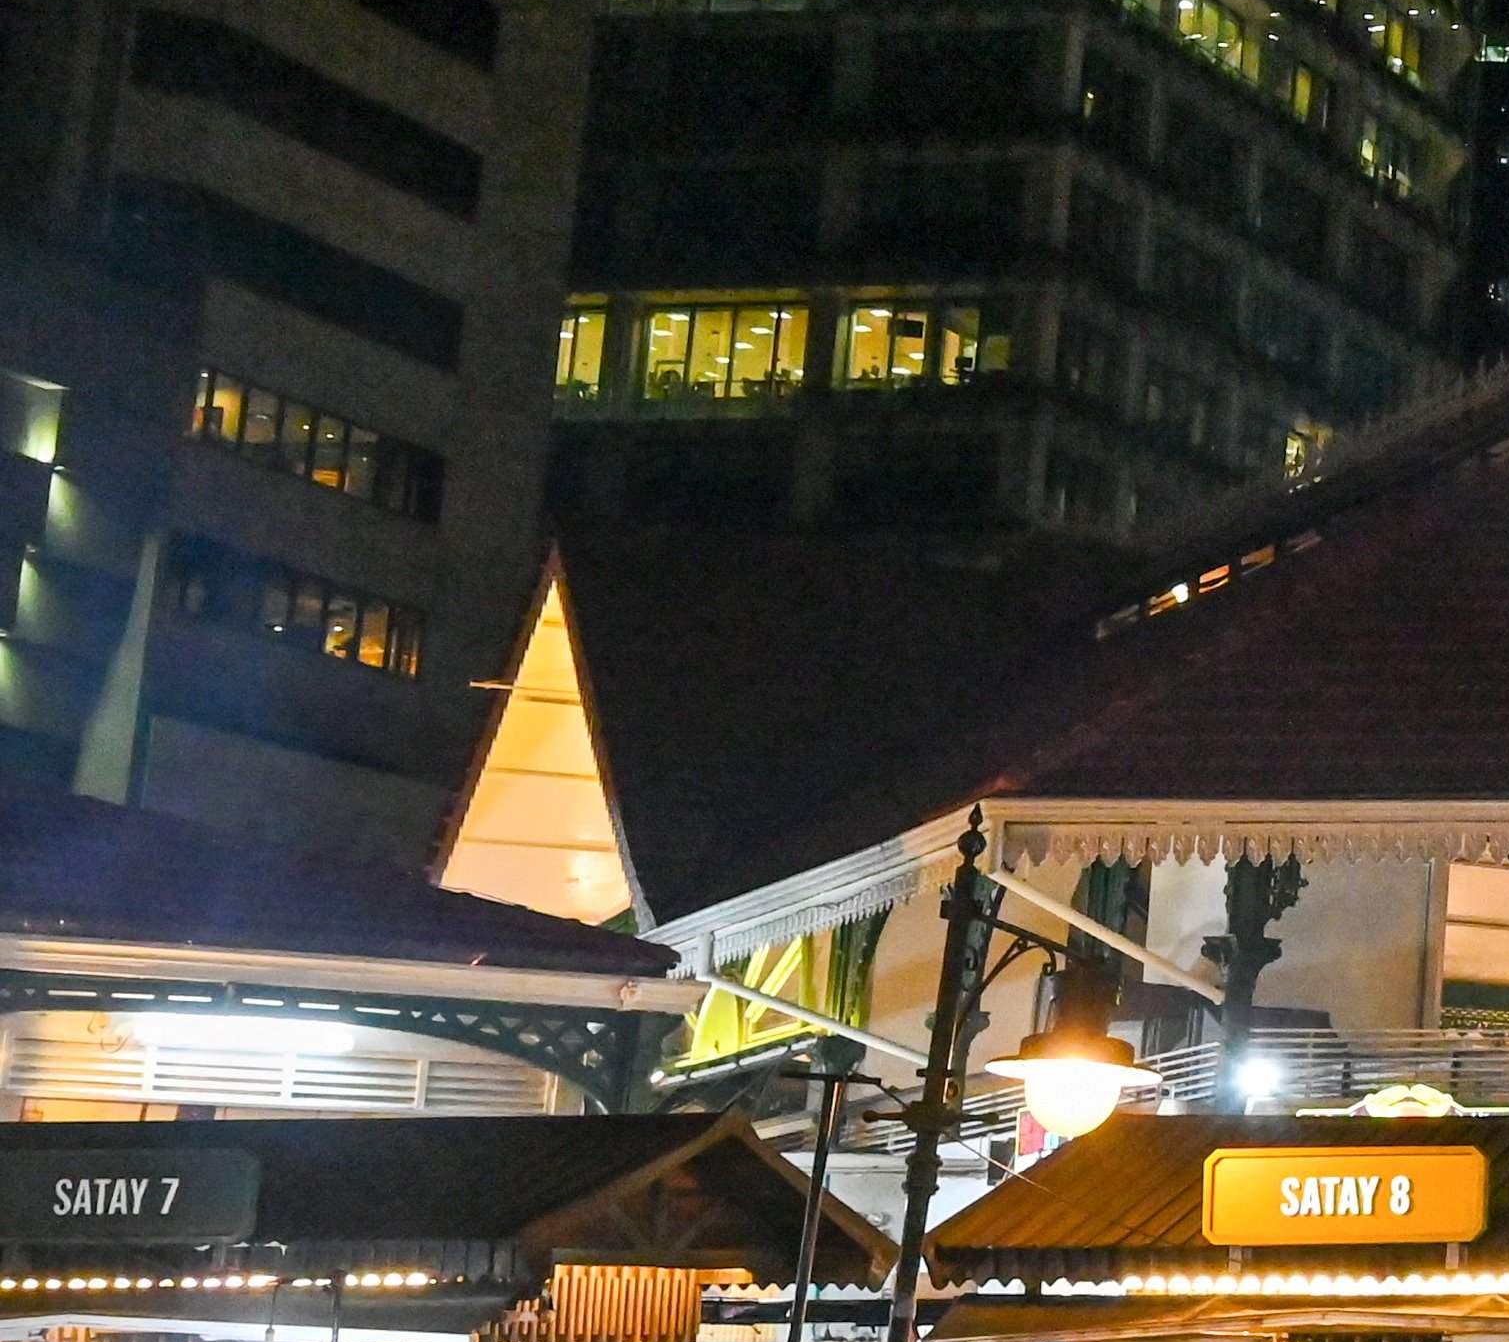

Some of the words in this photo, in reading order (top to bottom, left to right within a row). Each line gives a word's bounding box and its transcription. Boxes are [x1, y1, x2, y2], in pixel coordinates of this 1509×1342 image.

[53, 1178, 149, 1216] SATAY
[160, 1177, 180, 1215] 7
[1280, 1176, 1380, 1217] SATAY
[1389, 1175, 1411, 1216] 8
